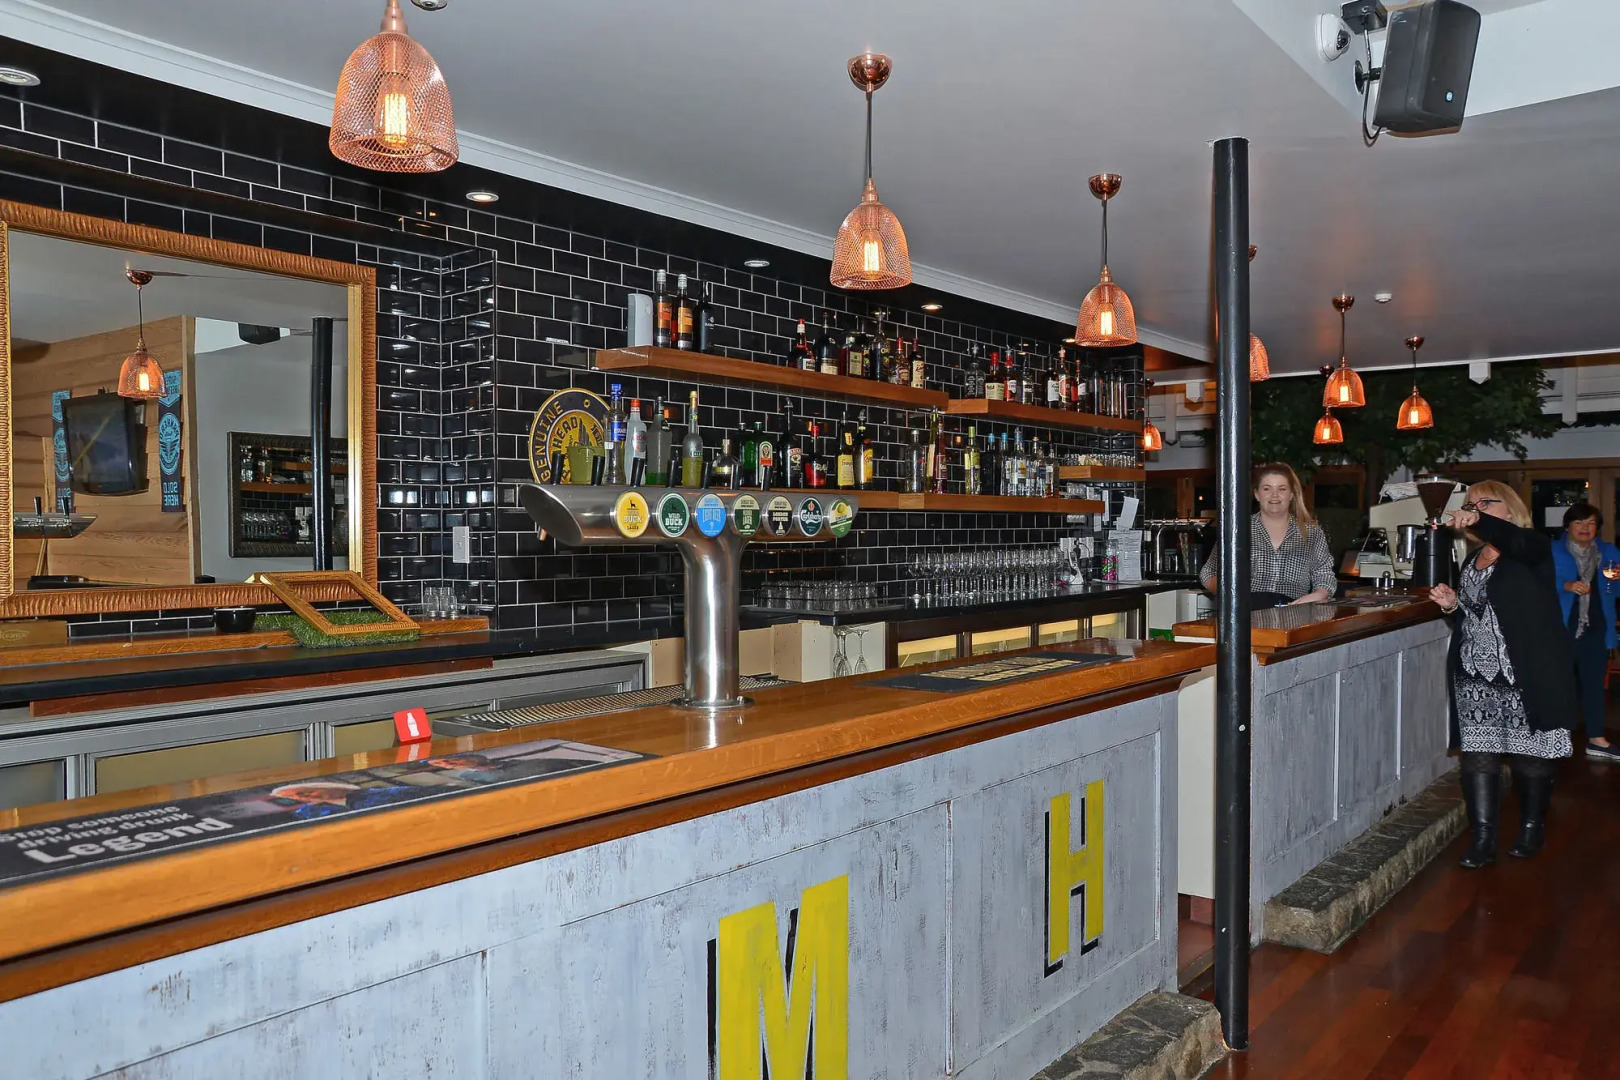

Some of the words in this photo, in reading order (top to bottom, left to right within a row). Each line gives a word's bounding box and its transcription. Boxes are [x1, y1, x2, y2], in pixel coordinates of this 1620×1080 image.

[533, 400, 564, 482] GENUINE
[623, 515, 642, 523] BUCK
[664, 518, 684, 526] BUCK
[17, 826, 119, 850] driving
[118, 812, 195, 831] drunk
[67, 805, 181, 830] someone
[23, 817, 234, 865] Legend
